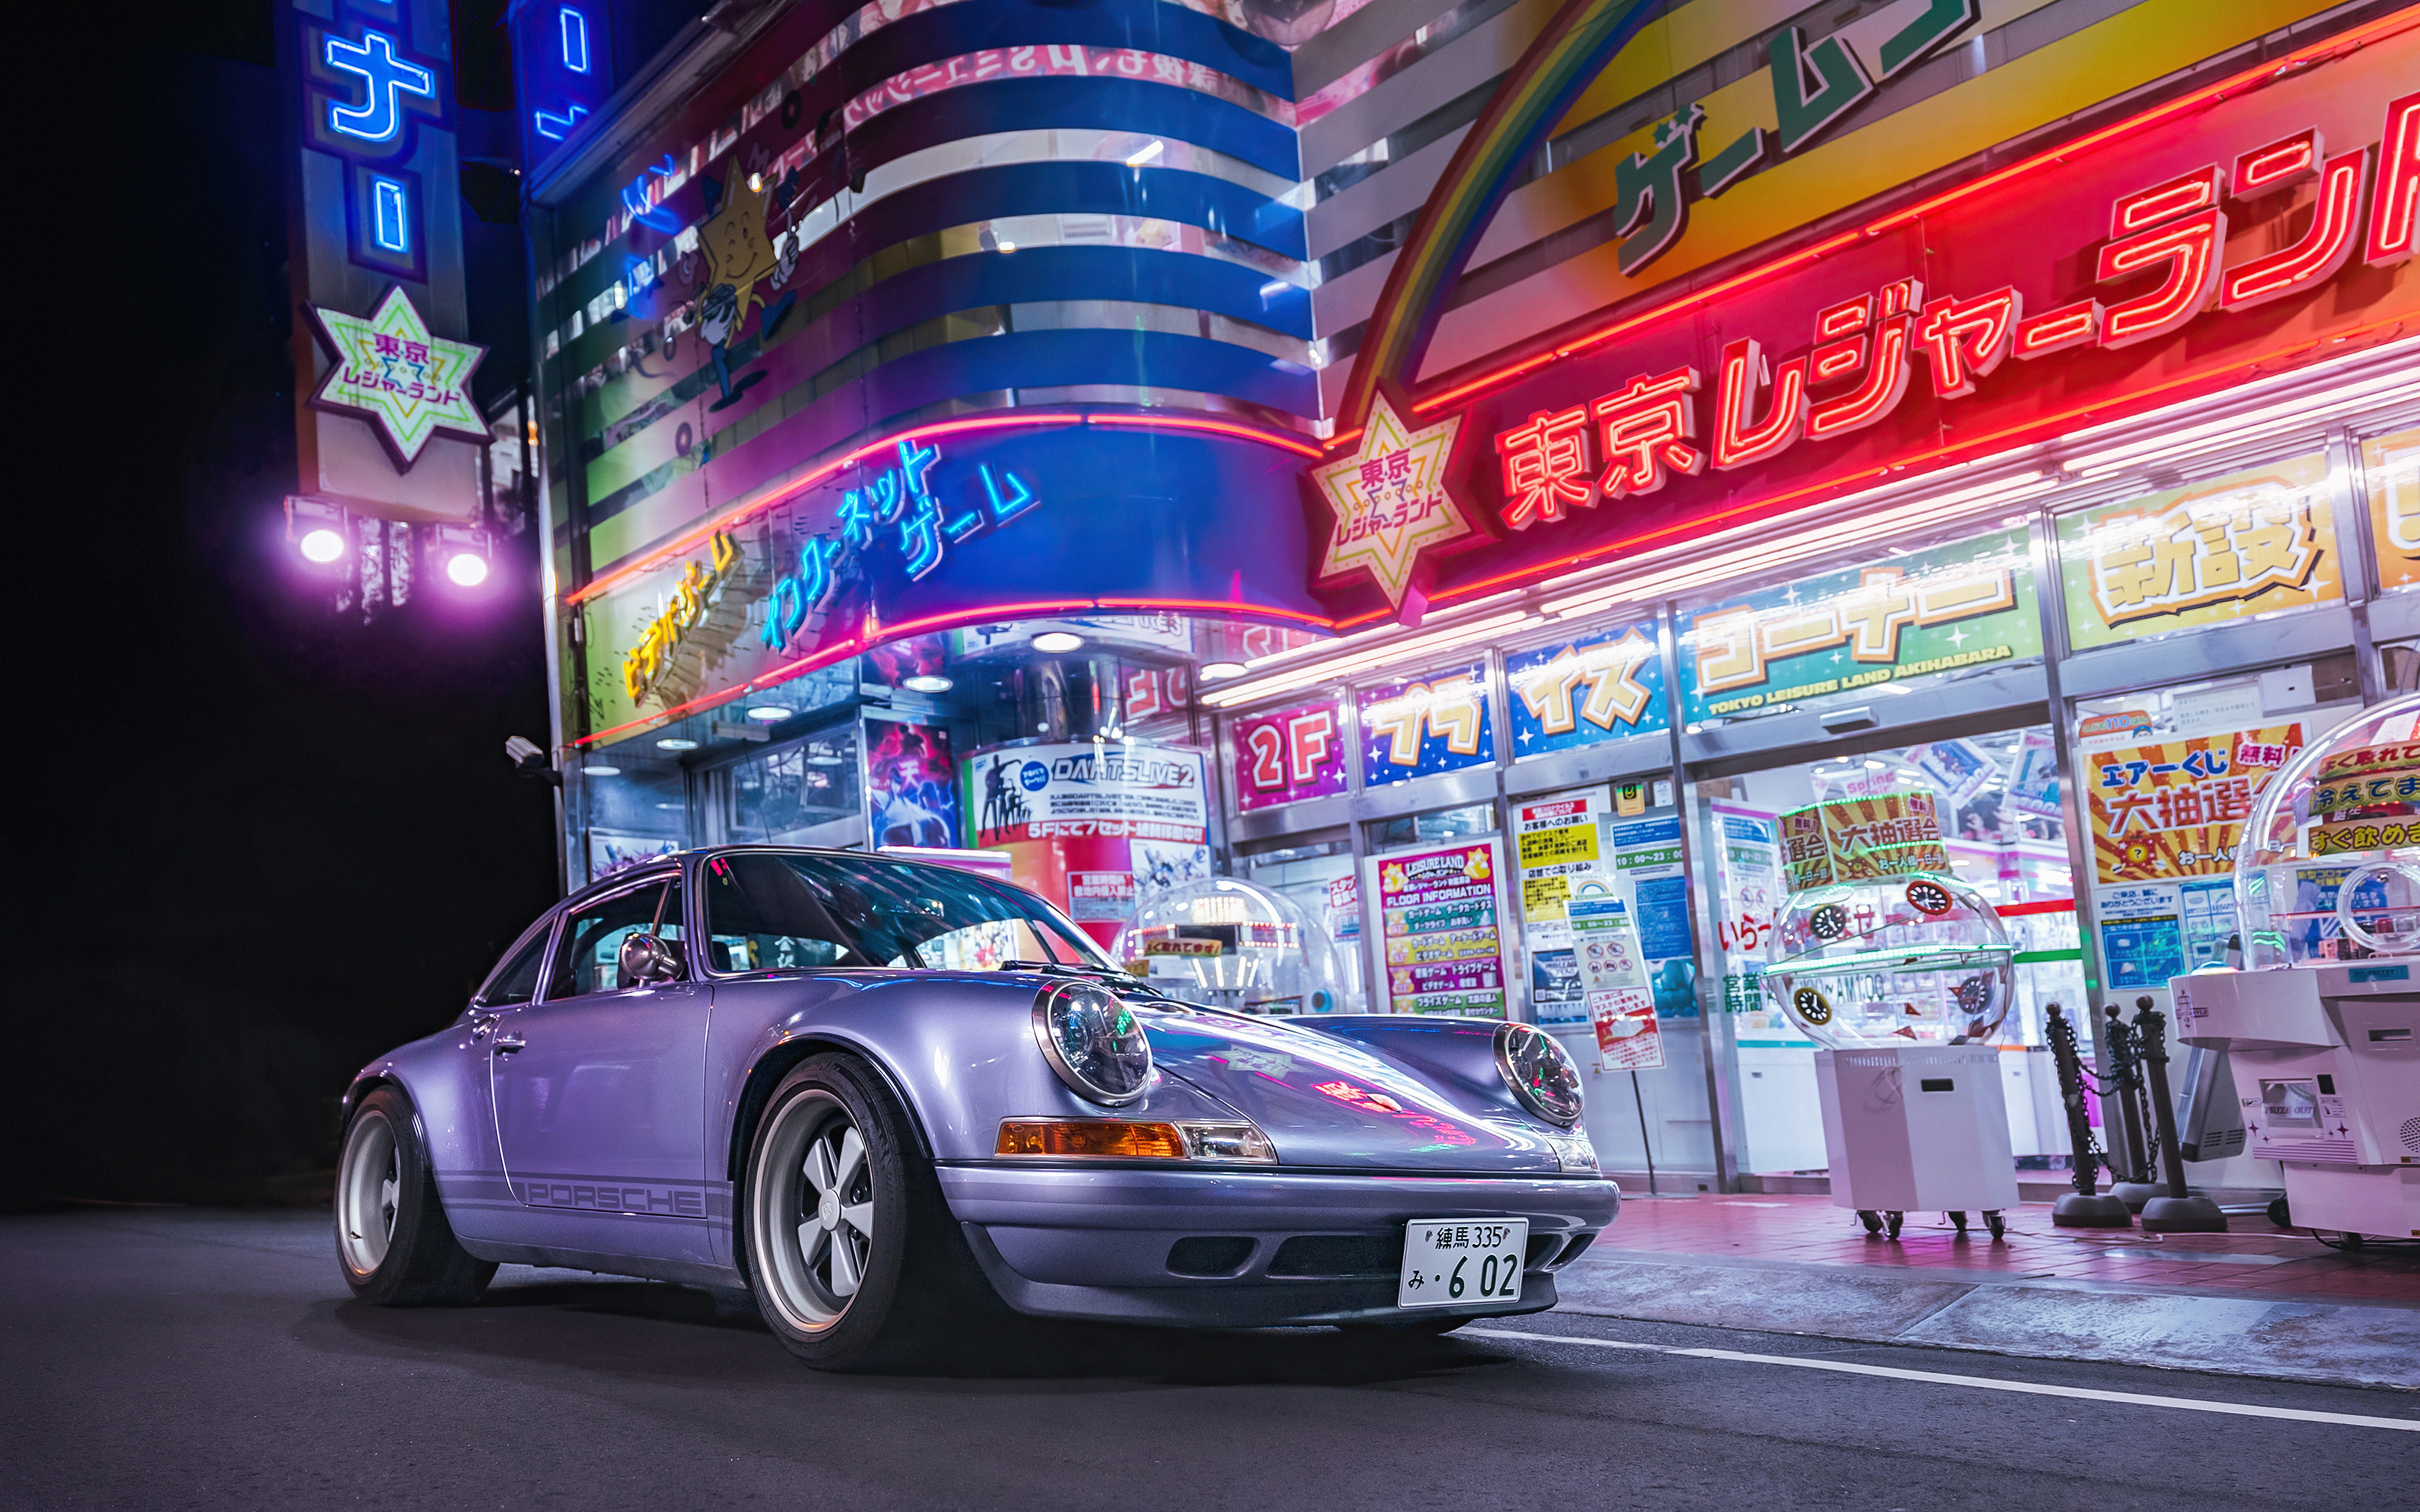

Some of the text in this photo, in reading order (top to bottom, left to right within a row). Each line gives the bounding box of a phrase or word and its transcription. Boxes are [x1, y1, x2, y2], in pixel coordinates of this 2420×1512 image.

[323, 0, 437, 253] ナー
[373, 332, 430, 364] 東京
[341, 365, 461, 406] レジャーランド
[1359, 447, 1413, 491] 東京
[902, 462, 1041, 582] ゲーム
[1336, 490, 1443, 547] レジャーランド
[2095, 484, 2311, 618] 新設
[1692, 567, 2019, 697] コーナー
[1708, 644, 2012, 716] TOKYO LEISURE LAND AKIHABARA
[1247, 707, 1337, 794] 2F
[2101, 748, 2230, 788] エアーくじ
[1052, 757, 1195, 789] DARTSLIVE2
[1387, 883, 1491, 907] FLOOR INFORMATION
[1723, 971, 1761, 994] 営業
[1724, 992, 1763, 1014] 時間
[2264, 1106, 2292, 1115] PRIZE
[527, 1181, 703, 1214] PORSCHE
[1435, 1226, 1504, 1250] 練馬 335
[1408, 1269, 1425, 1290] み
